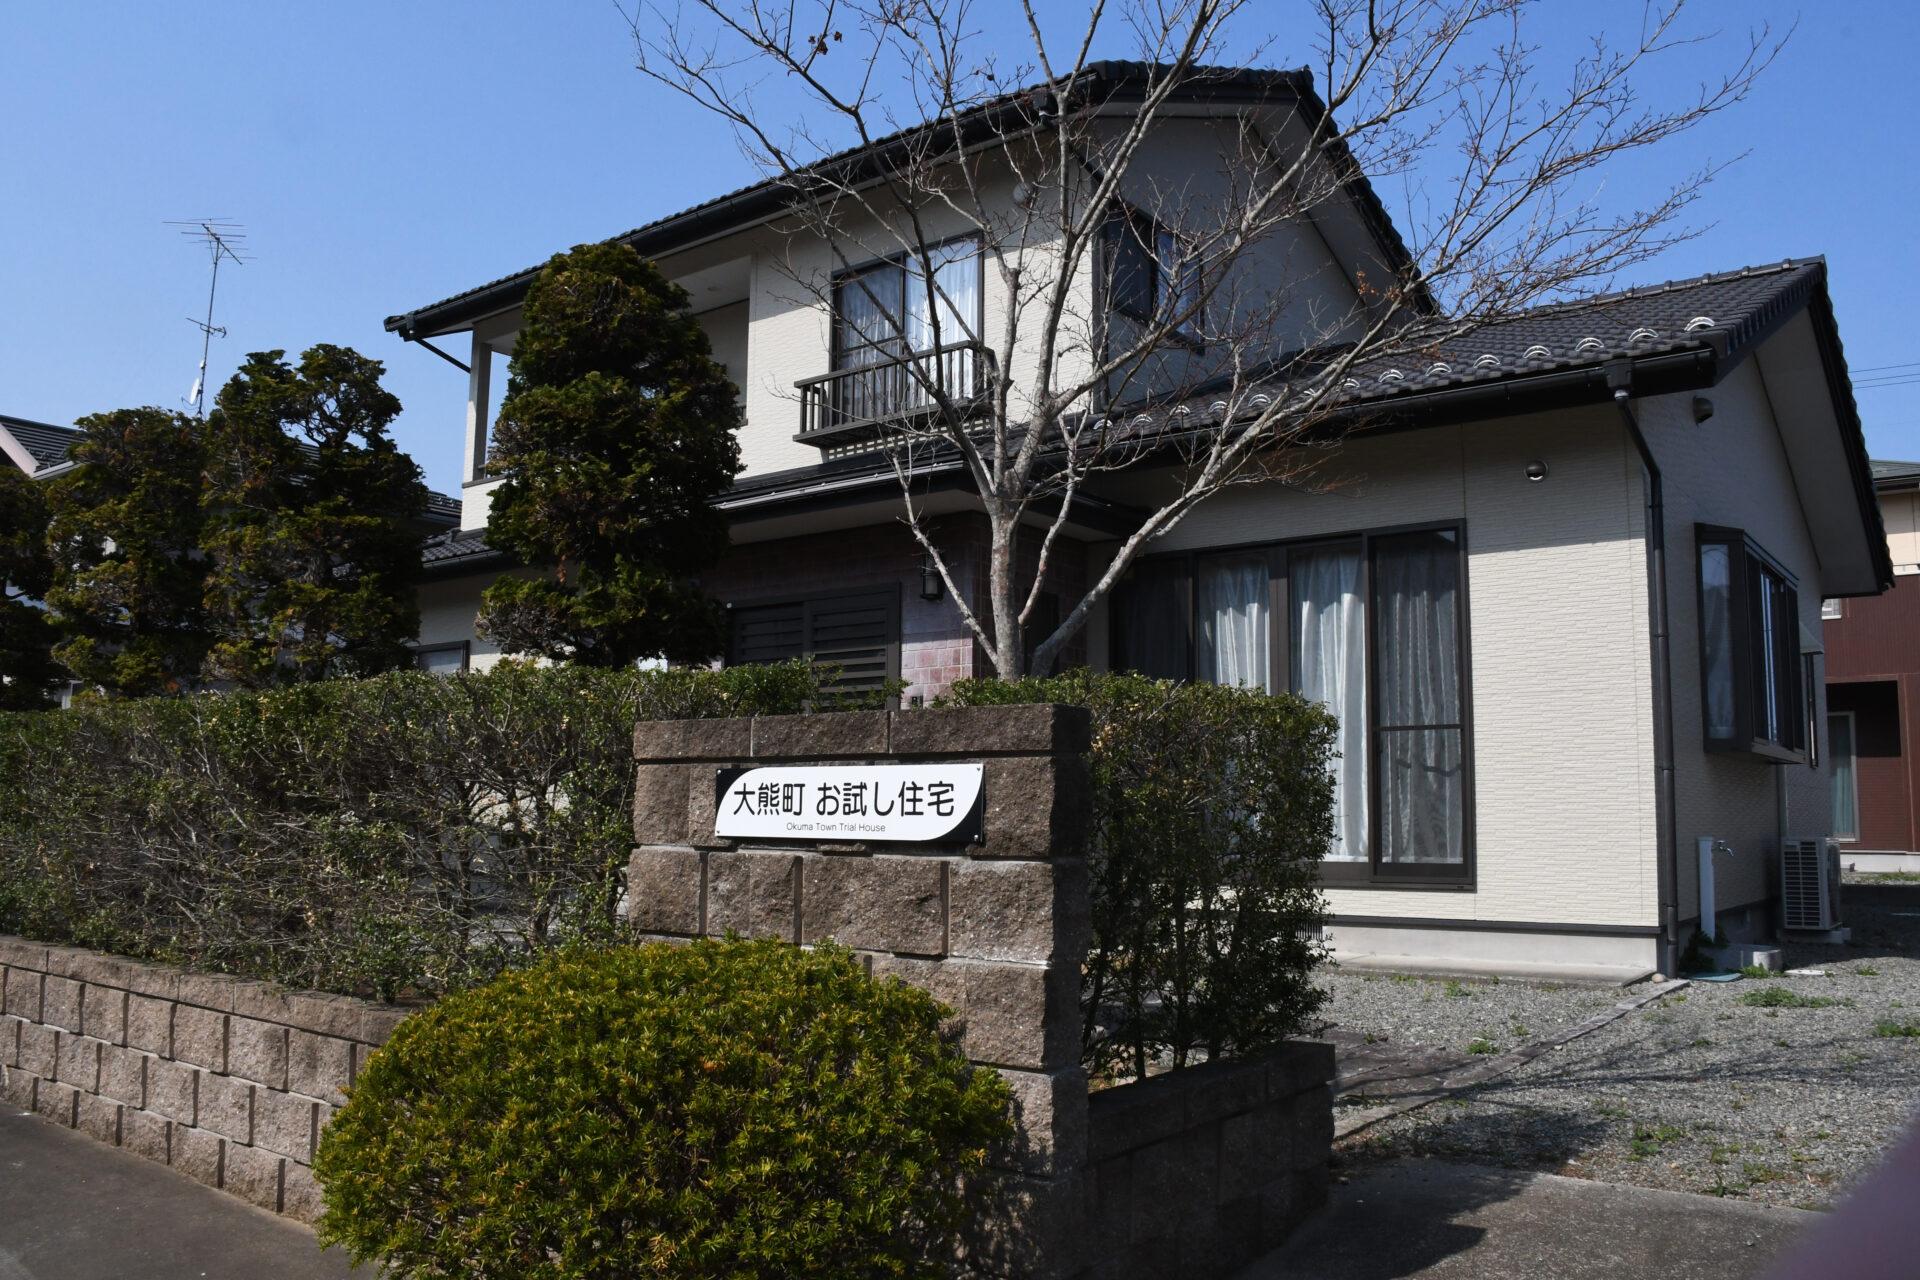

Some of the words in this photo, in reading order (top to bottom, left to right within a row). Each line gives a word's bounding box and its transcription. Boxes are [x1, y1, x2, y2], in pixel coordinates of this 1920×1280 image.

[733, 782, 806, 816] 大熊町
[816, 781, 955, 817] お試し住宅
[786, 822, 814, 831] Okuma
[816, 822, 837, 832] Town
[839, 822, 857, 832] Trial
[858, 823, 886, 832] House
